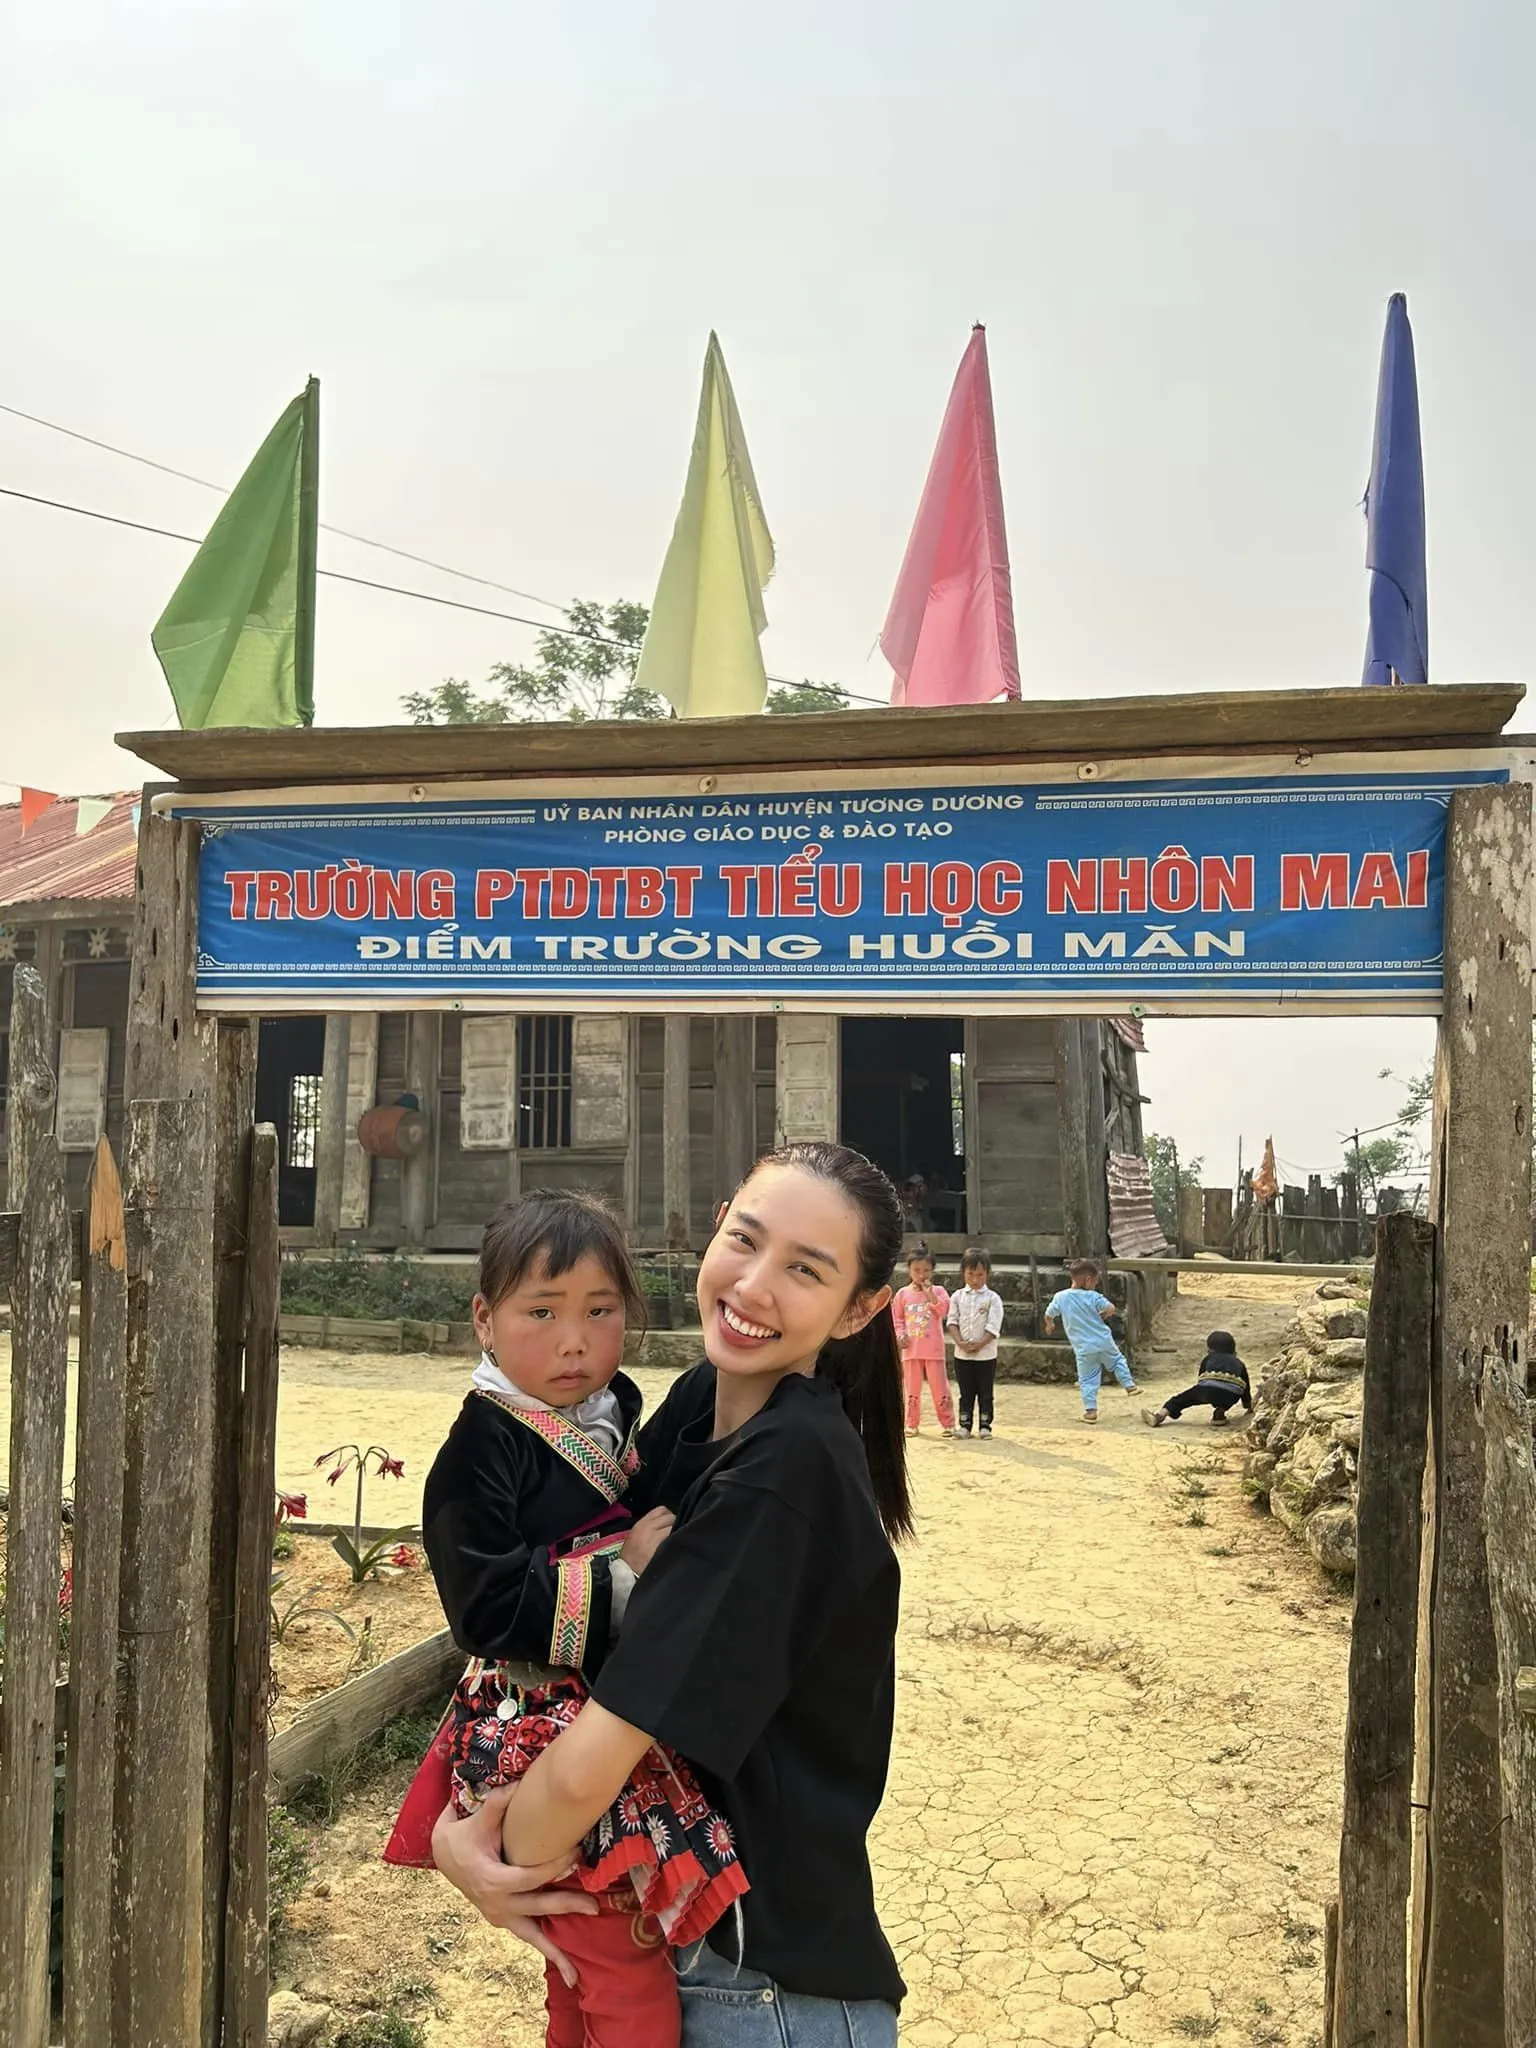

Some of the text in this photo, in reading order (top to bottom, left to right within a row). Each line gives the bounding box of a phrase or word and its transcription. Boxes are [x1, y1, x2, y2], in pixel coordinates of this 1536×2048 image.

[543, 795, 1024, 822] UỶ BAN NHÂN DÂN HUYỆN TƯƠNG DƯƠNG
[604, 821, 953, 844] PHÒNG GIÁO DỤC & ĐÀO TẠO
[224, 843, 1430, 928] TRƯỜNG PTDTBT TIỂU HỌC NHÔN MAI
[357, 922, 512, 960] ĐIỂM
[535, 928, 822, 960] TRƯỜNG
[849, 921, 1033, 959] HUỒI
